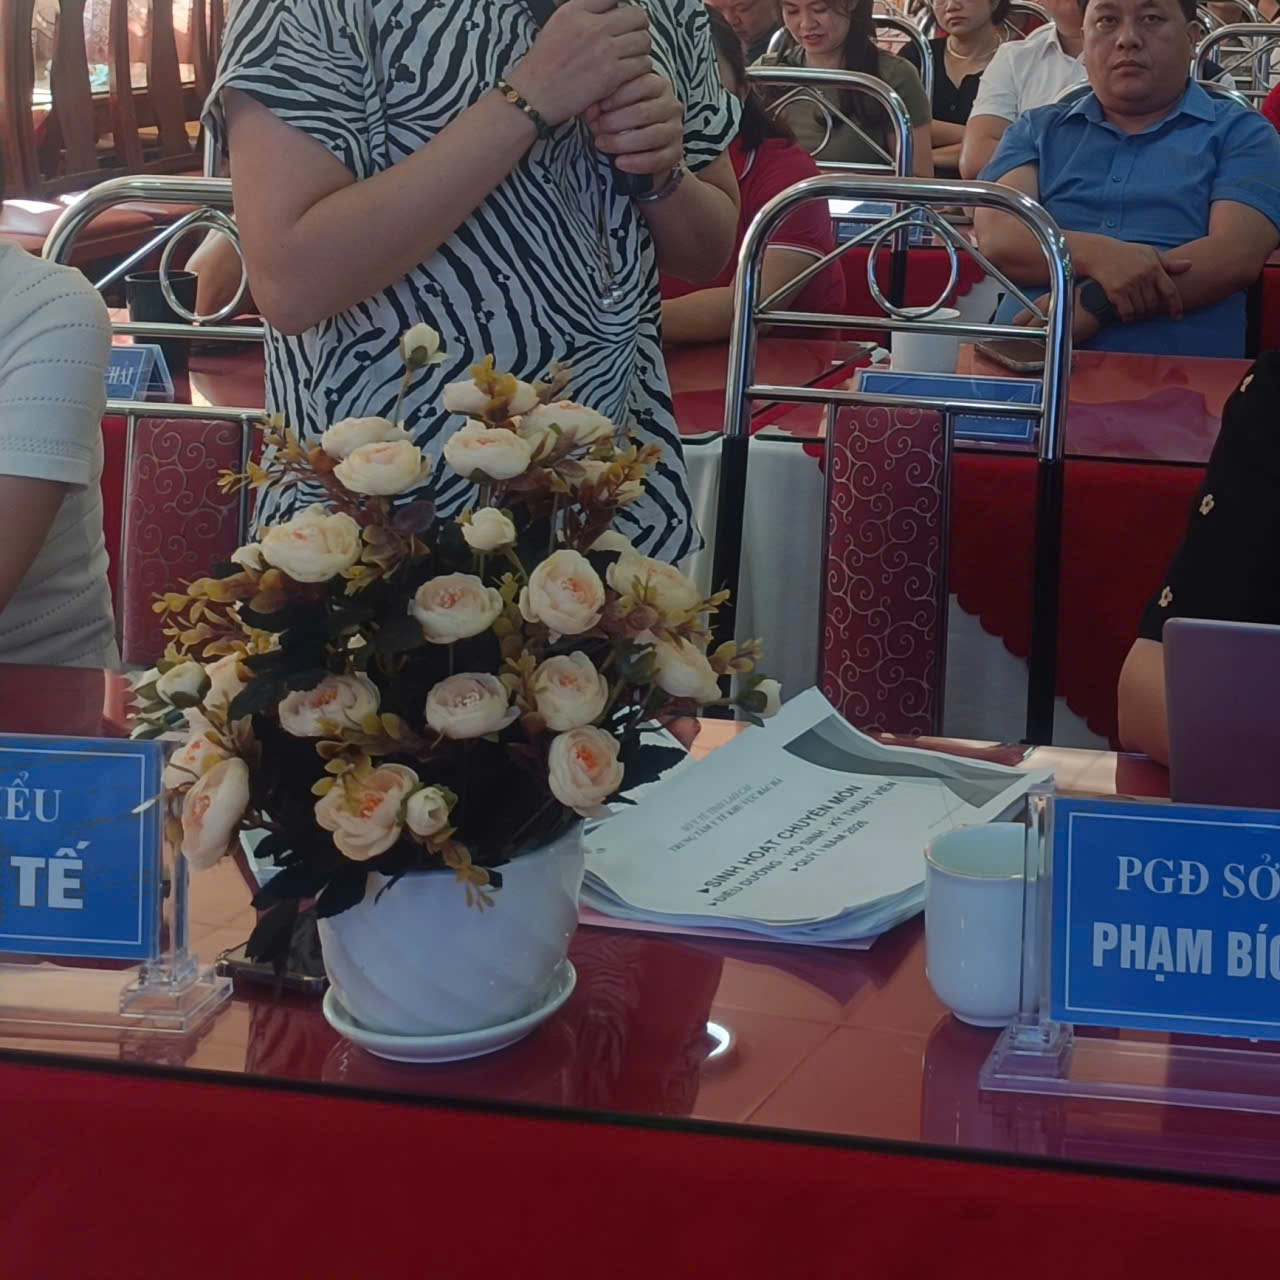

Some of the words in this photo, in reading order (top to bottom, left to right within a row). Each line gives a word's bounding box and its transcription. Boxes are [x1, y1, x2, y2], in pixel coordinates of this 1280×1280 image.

[704, 865, 745, 888] SINH
[777, 804, 835, 839] CHUYÊN
[827, 785, 863, 805] MÔN
[10, 840, 91, 909] TẾ
[1116, 855, 1210, 897] PGĐ
[1092, 922, 1213, 982] PHẠM
